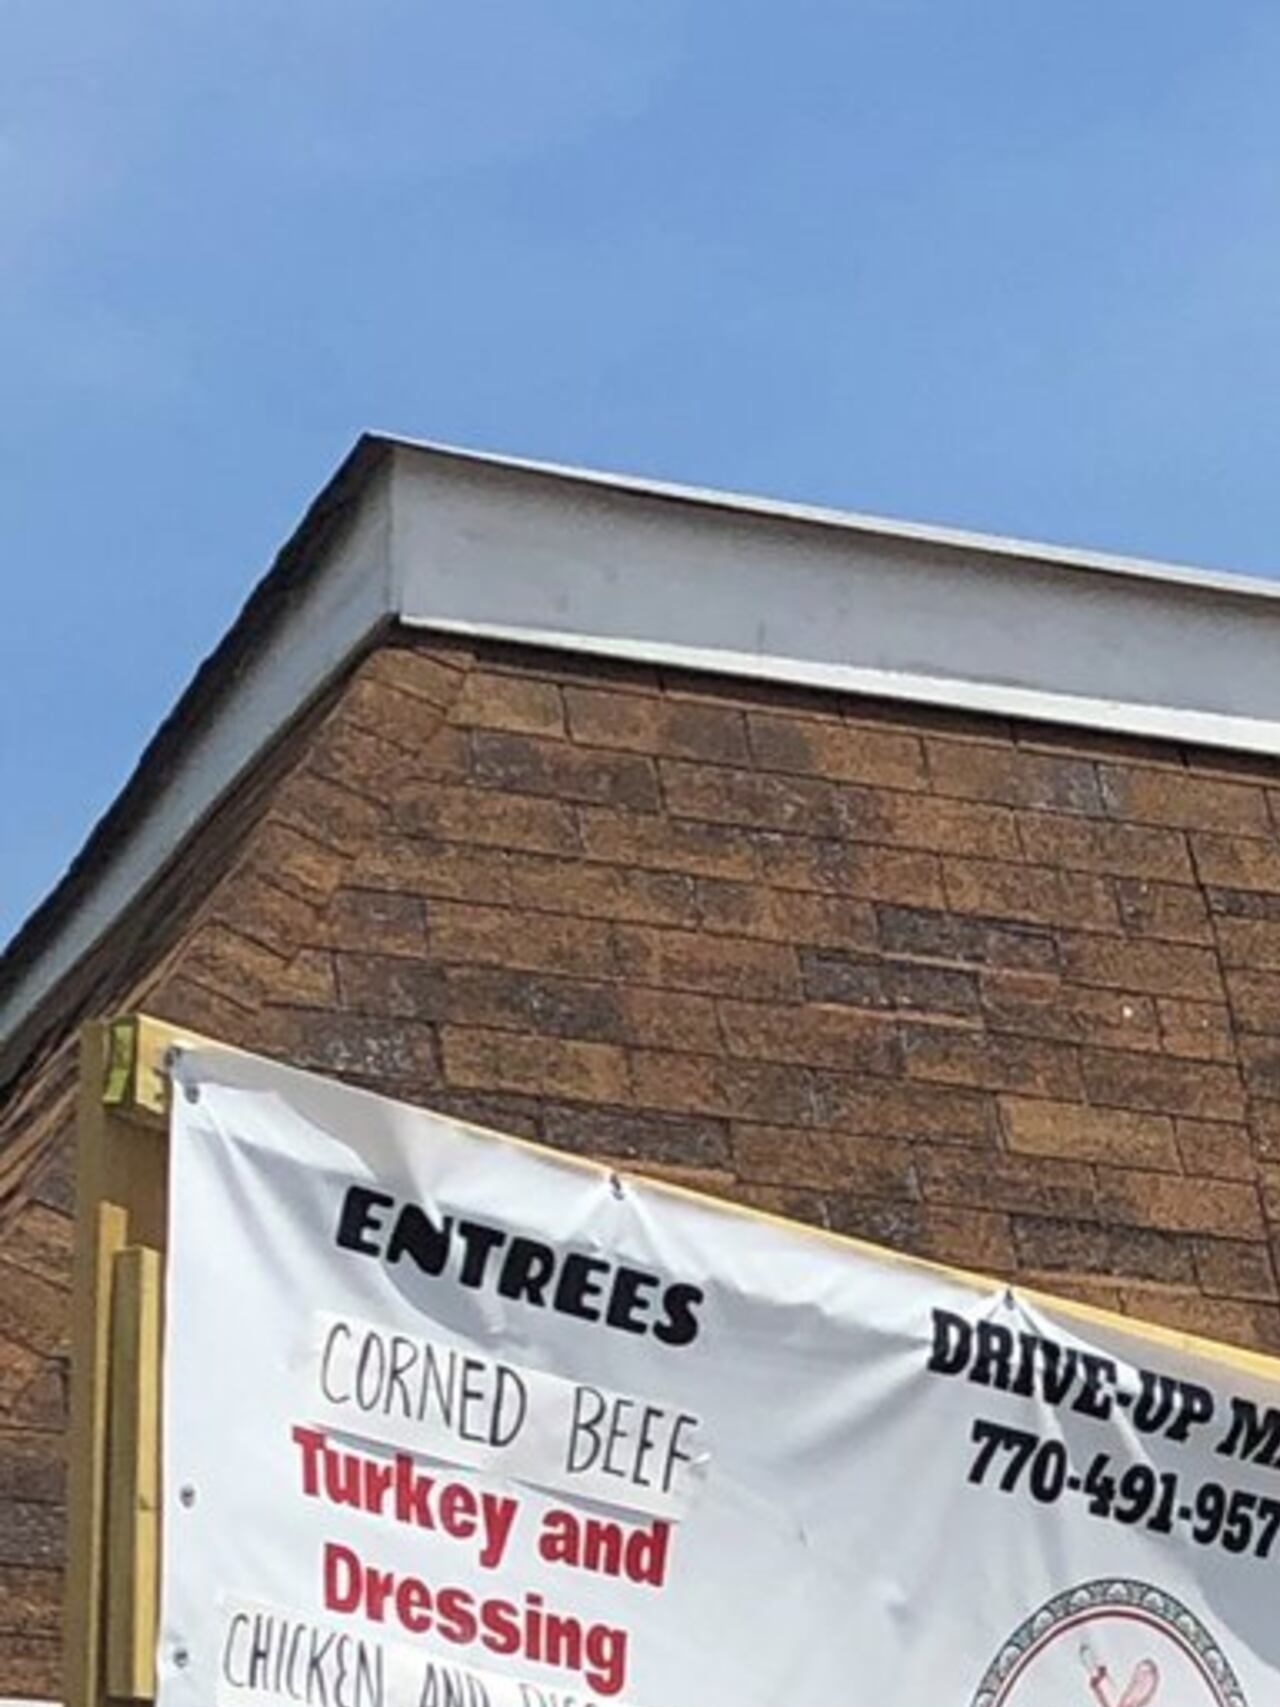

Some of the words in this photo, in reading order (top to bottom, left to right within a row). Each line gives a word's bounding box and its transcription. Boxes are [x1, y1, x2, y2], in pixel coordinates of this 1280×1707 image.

[336, 1185, 704, 1345] ENTREES
[320, 1323, 528, 1447] CORNED
[567, 1386, 698, 1492] BEEF
[927, 1309, 1216, 1443] DRIVE-UP
[292, 1426, 517, 1569] Turkey
[538, 1508, 671, 1587] and
[324, 1543, 627, 1695] Dressing
